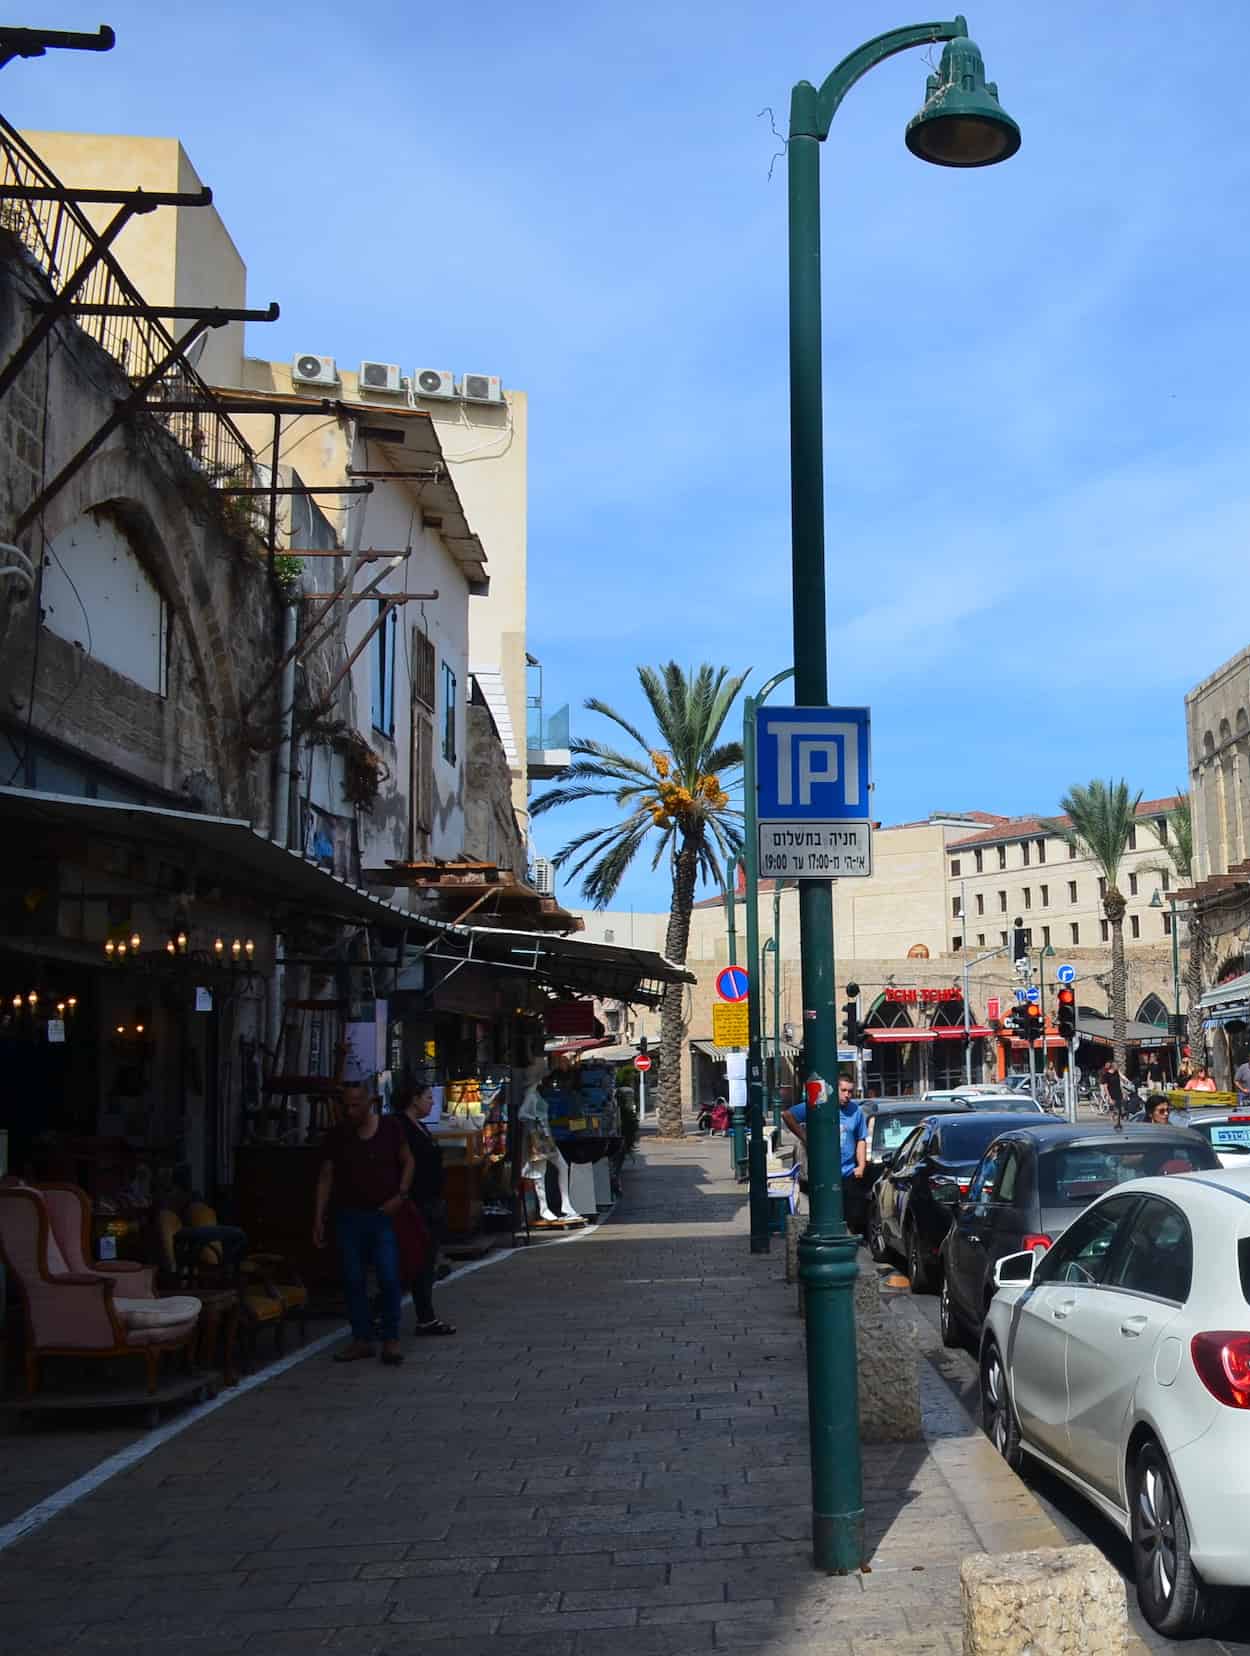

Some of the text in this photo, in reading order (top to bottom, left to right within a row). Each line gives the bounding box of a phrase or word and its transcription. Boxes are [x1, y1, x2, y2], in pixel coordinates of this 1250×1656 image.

[773, 831, 857, 847] חניה בתשלום
[765, 854, 787, 870] 19:00
[791, 857, 804, 870] עד
